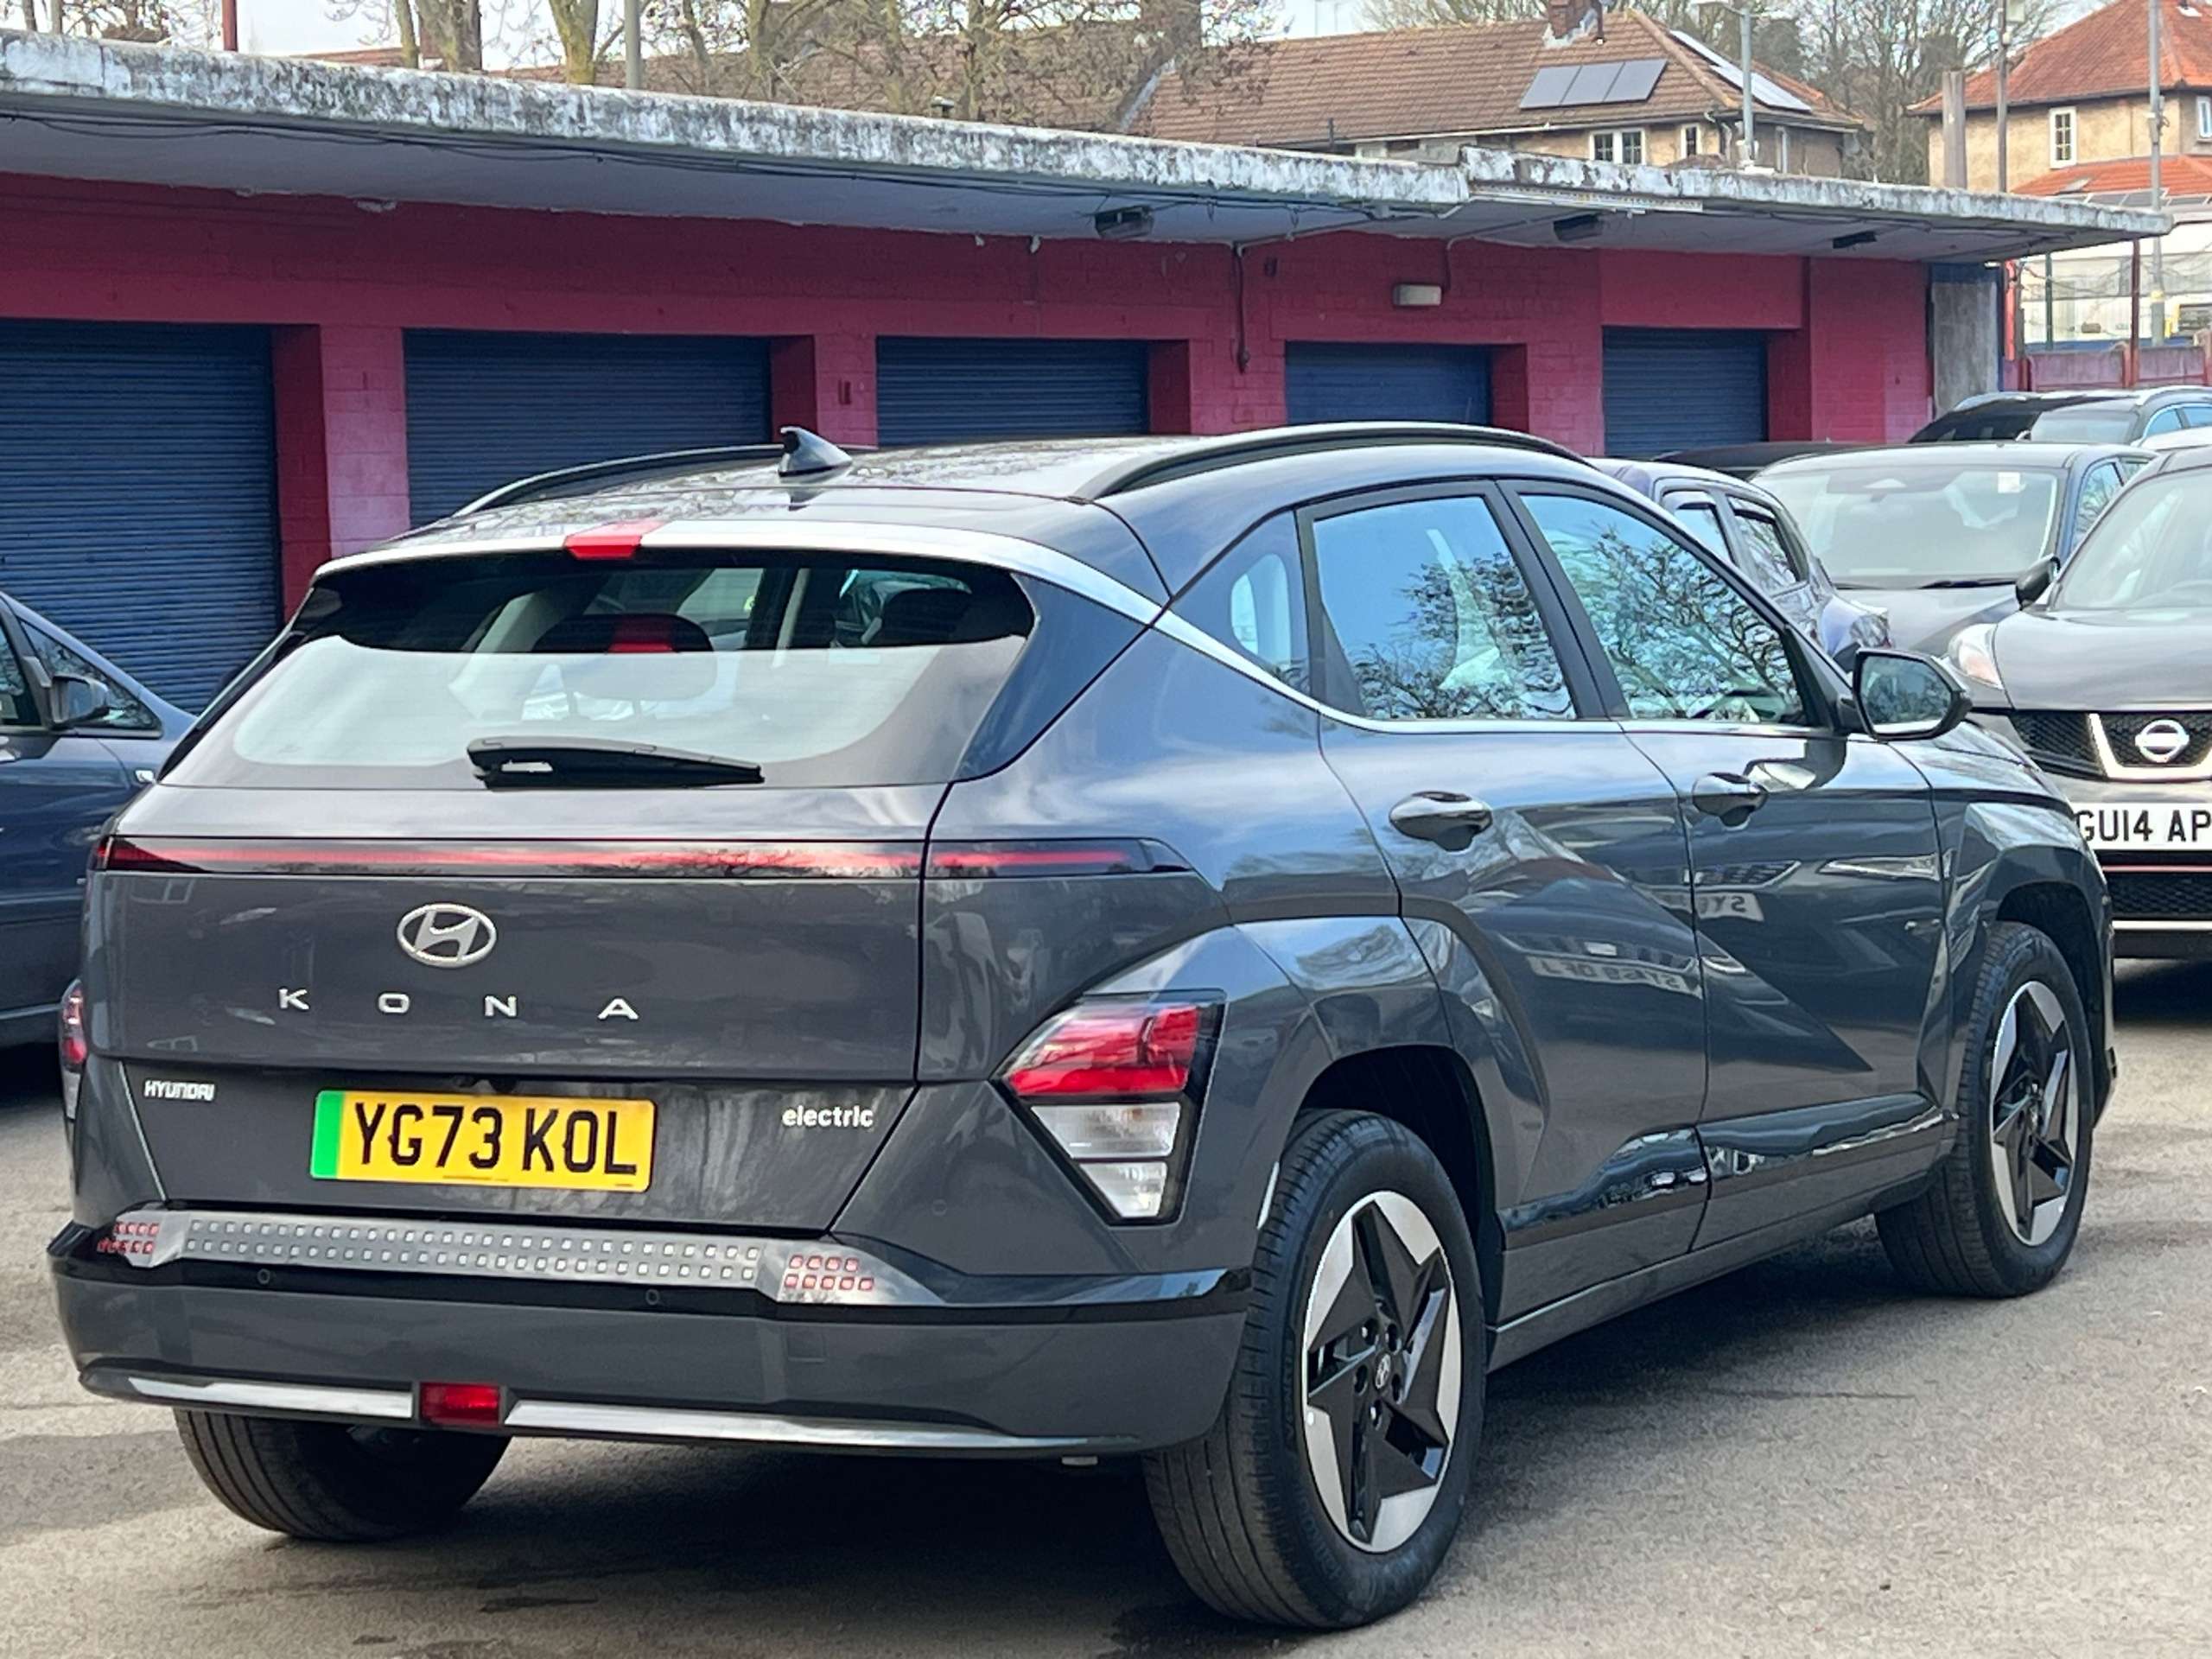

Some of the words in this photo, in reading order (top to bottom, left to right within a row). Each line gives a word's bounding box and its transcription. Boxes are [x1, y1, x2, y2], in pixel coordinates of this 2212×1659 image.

[2074, 810, 2153, 842] GU14
[278, 988, 639, 1020] KONA
[143, 1080, 215, 1102] HYUNDAI
[781, 1105, 874, 1128] electric
[354, 1102, 503, 1169] YG73
[521, 1107, 638, 1175] KOL
